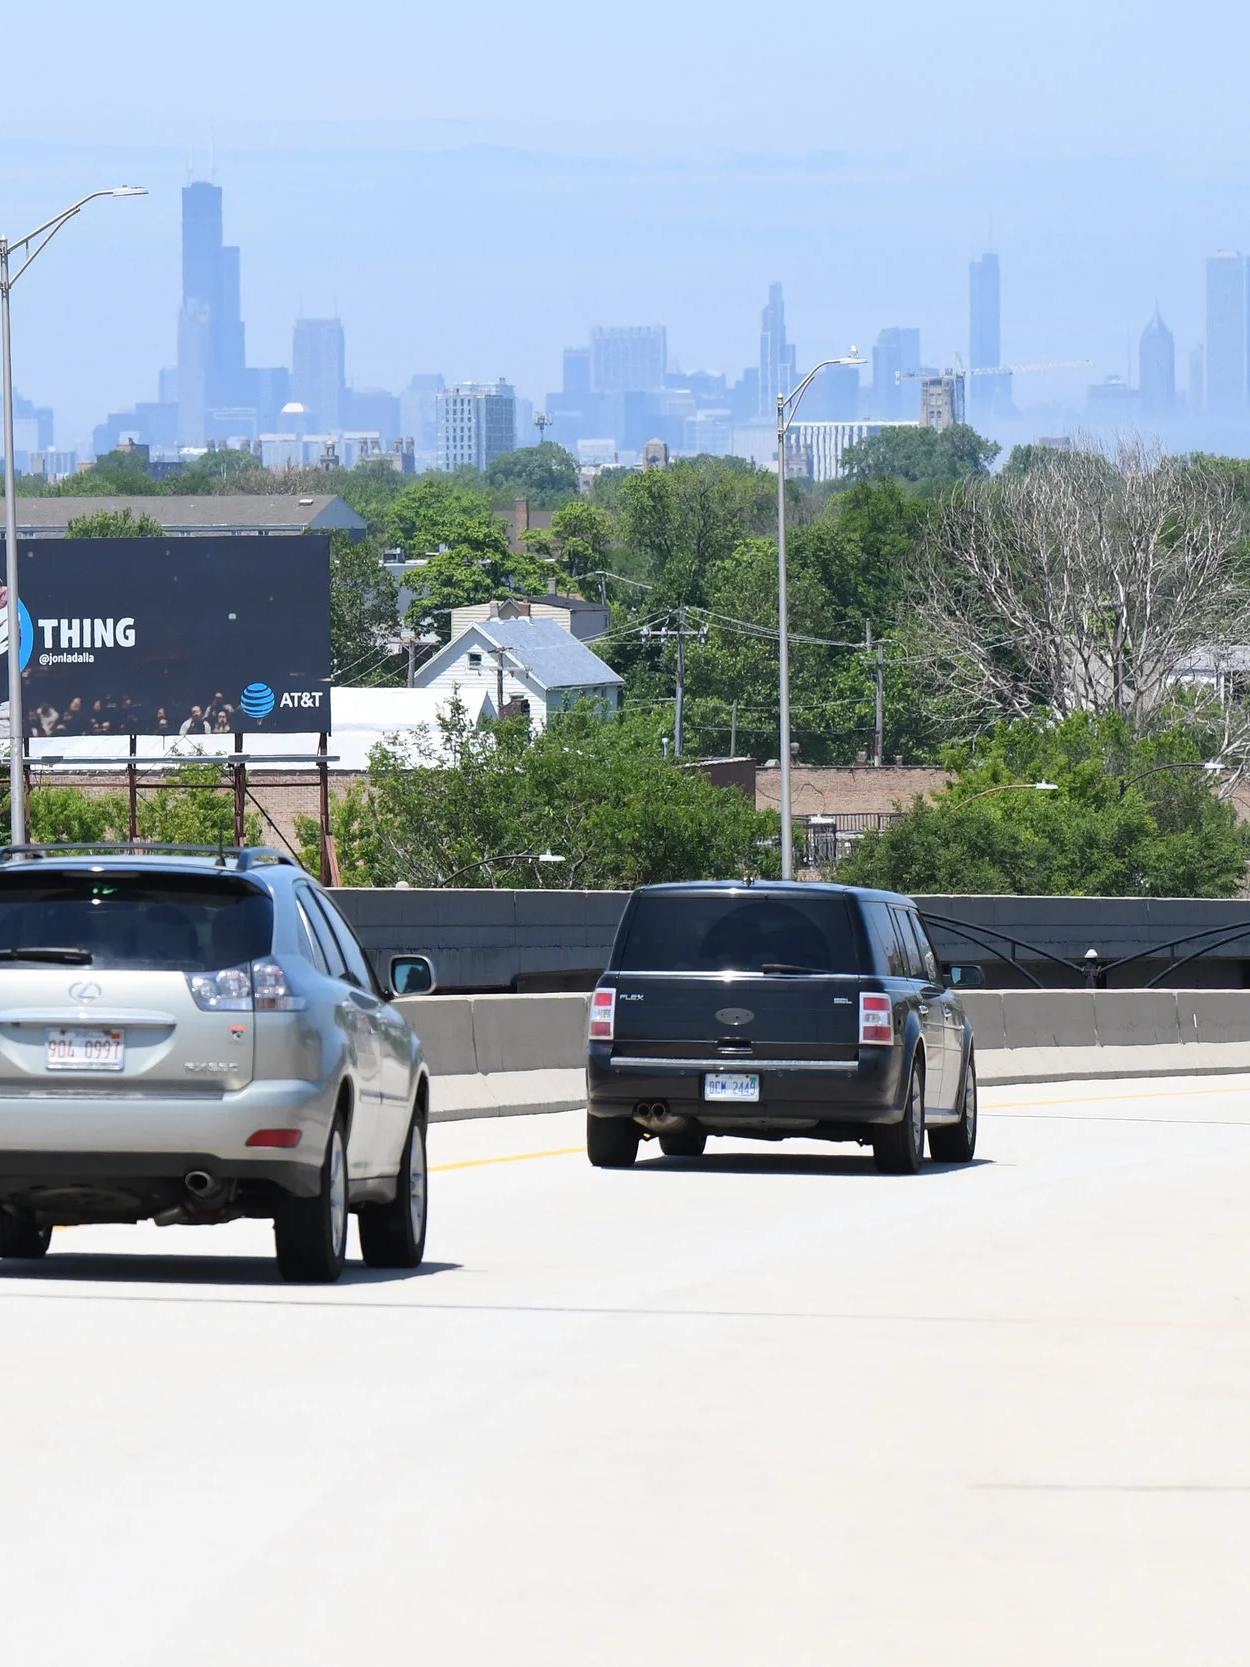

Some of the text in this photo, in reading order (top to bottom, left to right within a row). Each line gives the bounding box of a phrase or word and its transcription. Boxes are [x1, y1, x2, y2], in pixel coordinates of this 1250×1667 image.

[38, 617, 136, 649] THING
[39, 652, 94, 666] @jonladalla
[279, 691, 324, 708] AT&T
[619, 993, 644, 1001] FLEX
[48, 1039, 121, 1060] 904 0997
